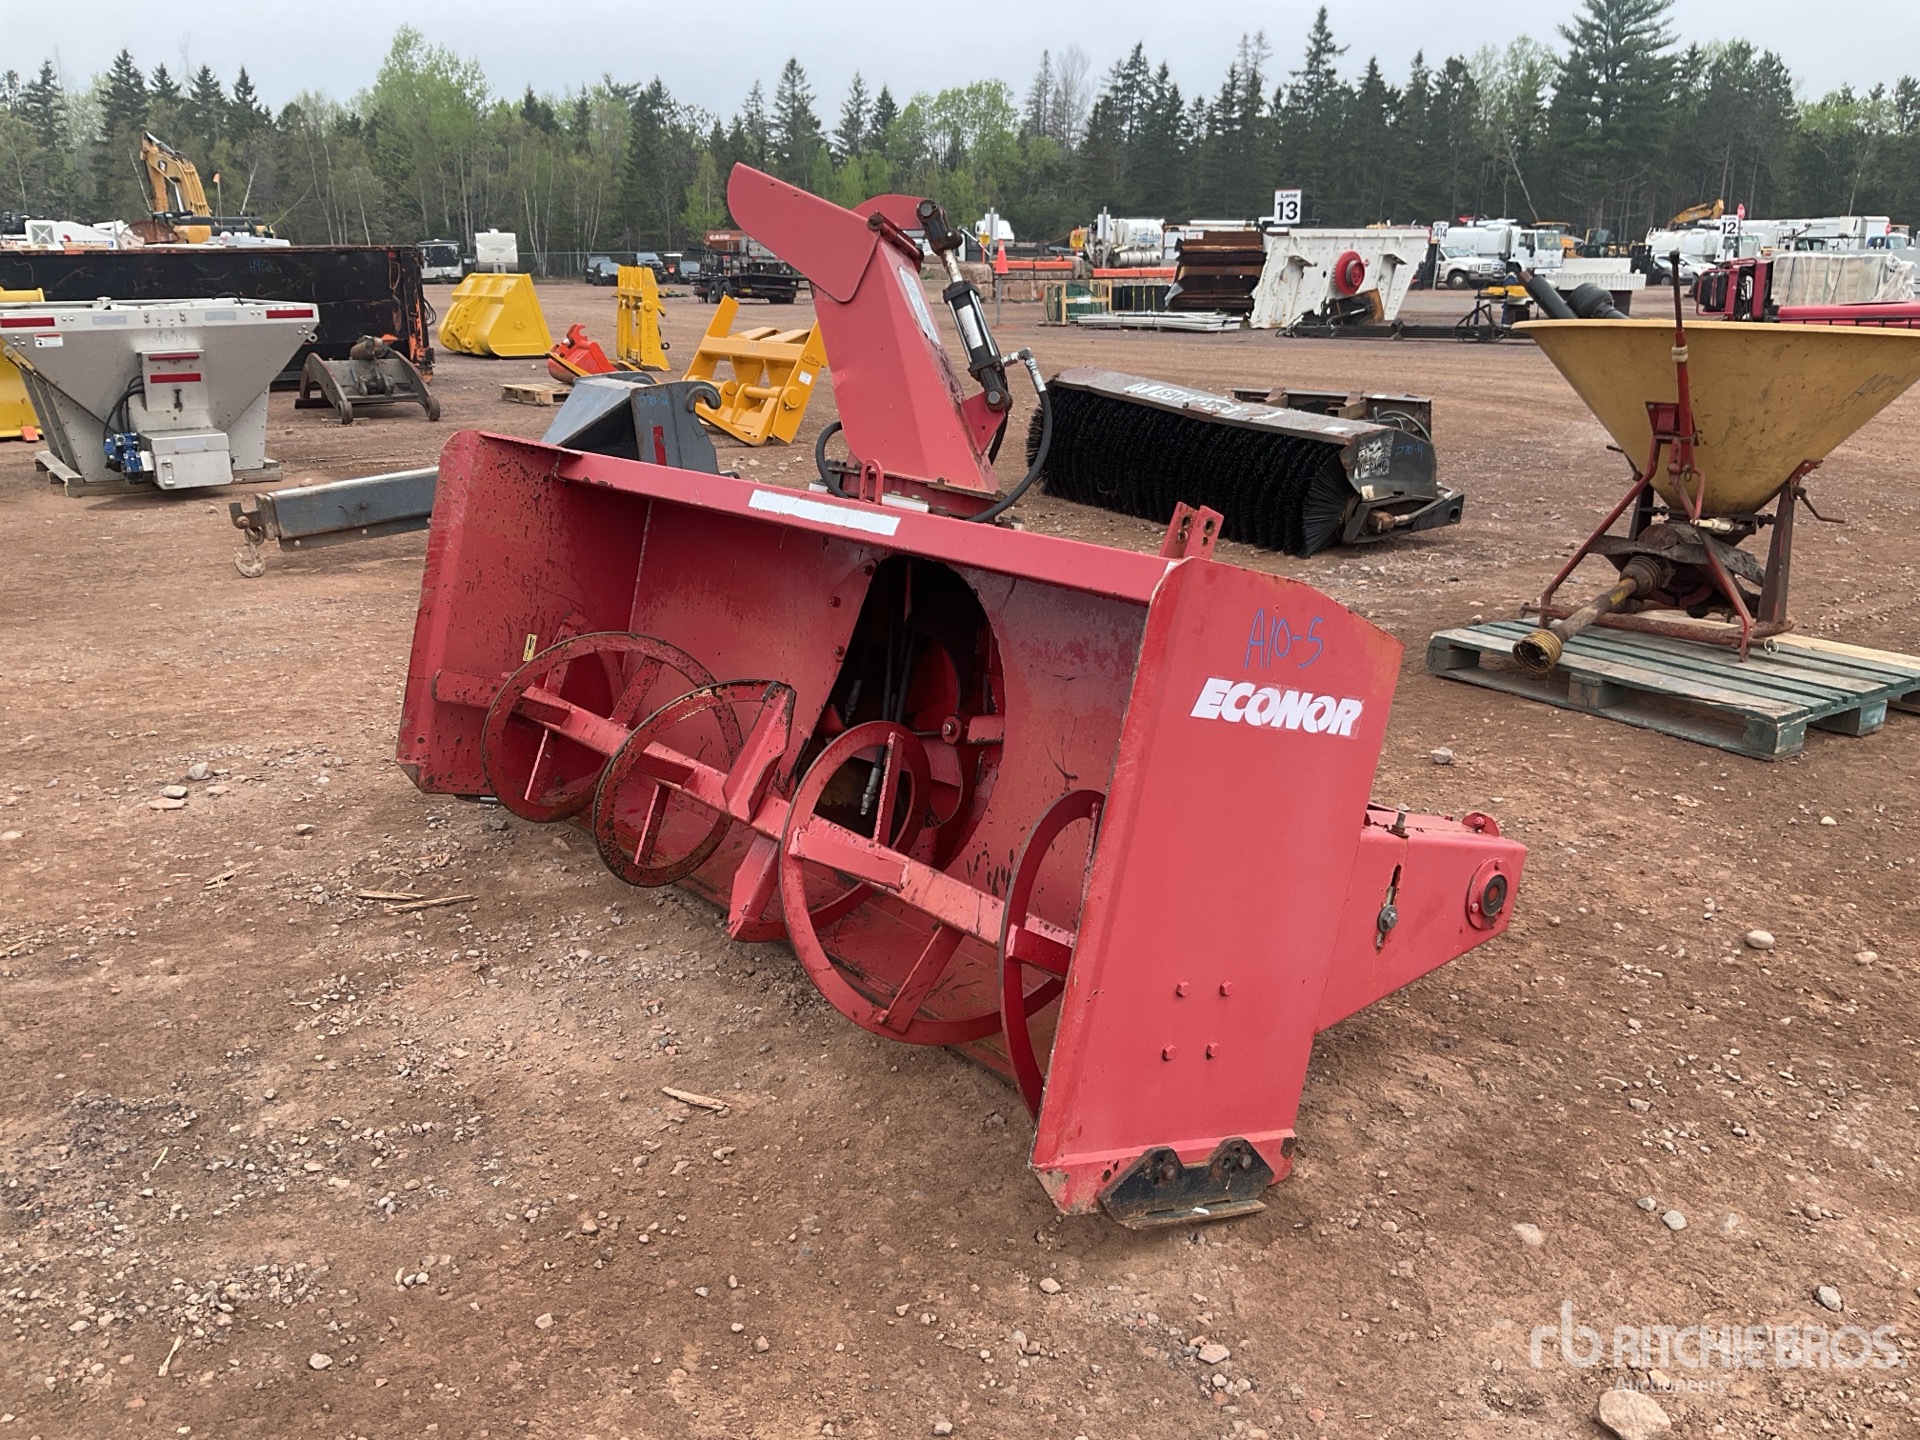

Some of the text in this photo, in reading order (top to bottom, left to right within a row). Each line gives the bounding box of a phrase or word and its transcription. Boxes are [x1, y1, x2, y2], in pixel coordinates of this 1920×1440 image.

[1277, 200, 1298, 221] 13
[1721, 221, 1737, 235] 12
[1244, 607, 1325, 670] A10-5
[1189, 677, 1364, 737] ECONOR
